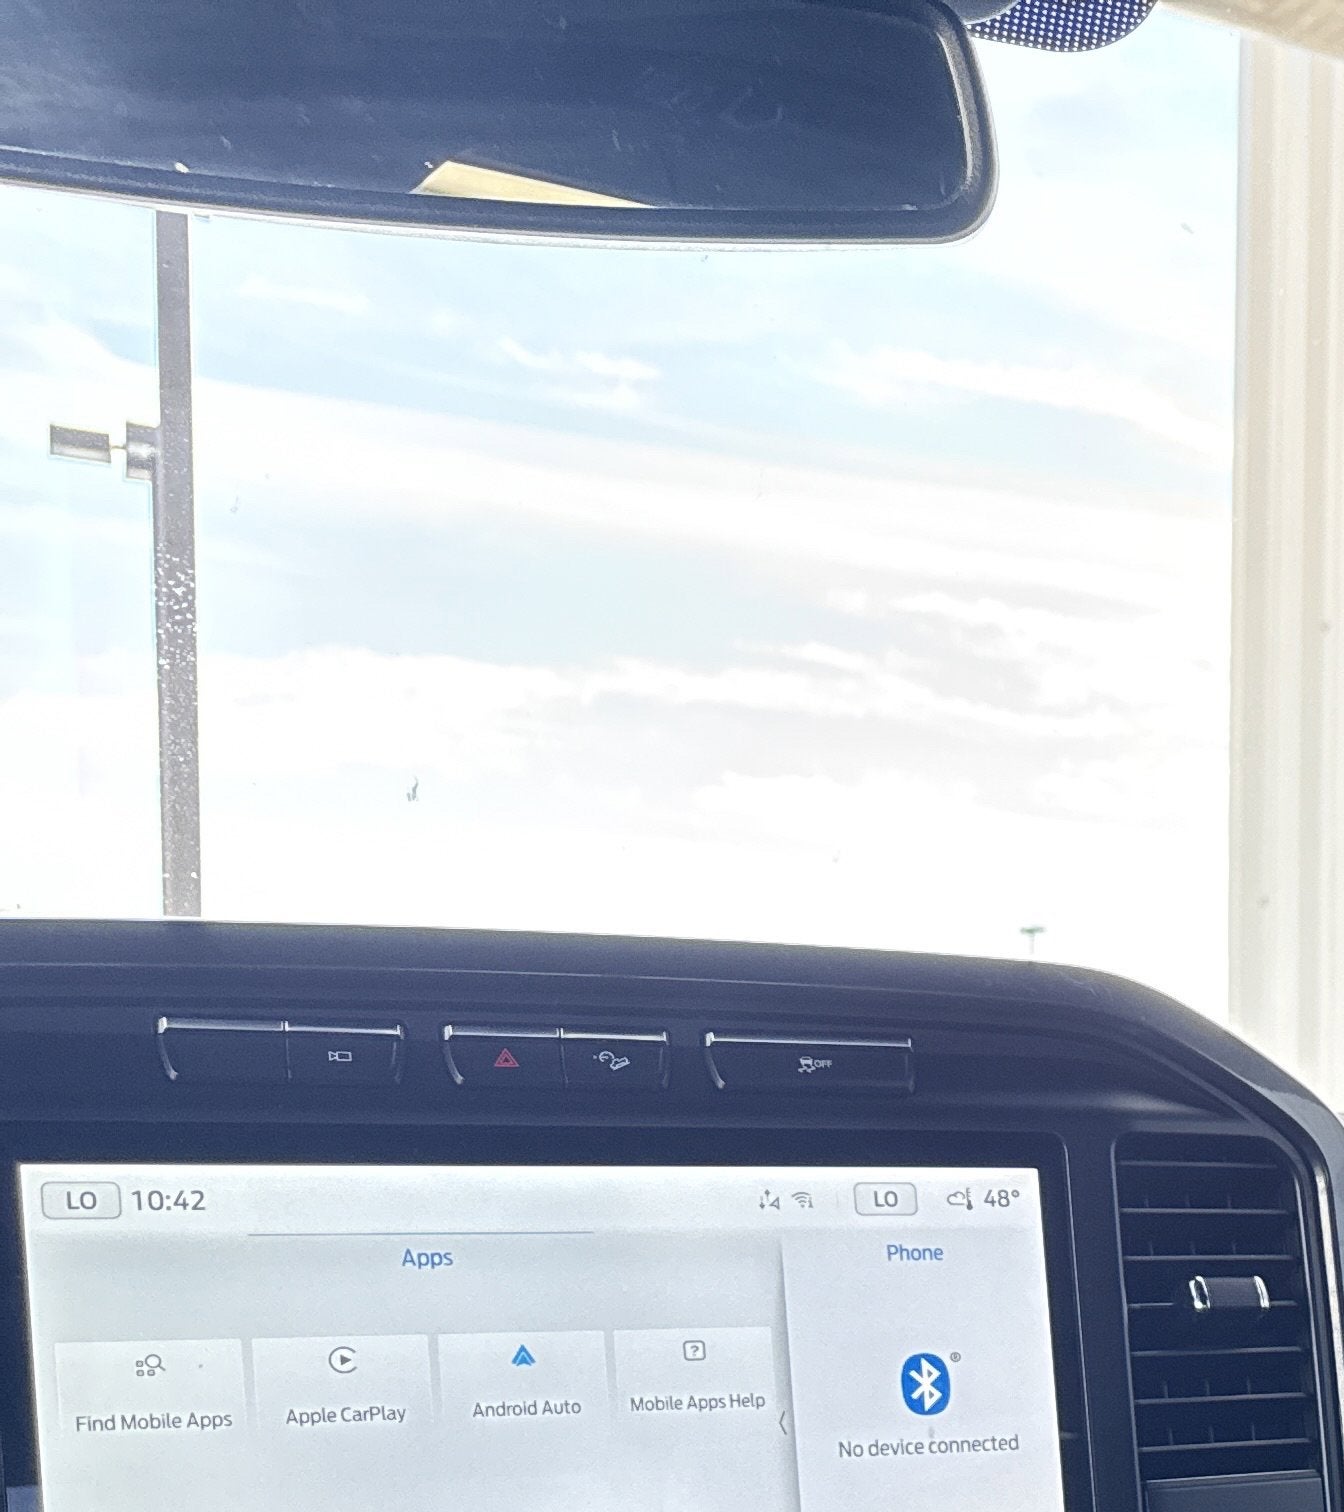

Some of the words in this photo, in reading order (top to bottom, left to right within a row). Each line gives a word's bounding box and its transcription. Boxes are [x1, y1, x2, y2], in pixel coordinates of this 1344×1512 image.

[814, 1059, 832, 1069] OFF
[66, 1190, 97, 1210] LO
[131, 1190, 206, 1211] 10:42
[873, 1190, 898, 1207] LO
[983, 1189, 1020, 1207] 48°
[401, 1248, 454, 1270] Apps
[886, 1244, 944, 1262] Phone
[472, 1400, 538, 1418] Android
[541, 1399, 582, 1415] Auto
[630, 1395, 683, 1412] Mobile
[686, 1395, 727, 1412] Apps
[728, 1392, 766, 1410] Help
[75, 1414, 116, 1432] Find
[120, 1413, 182, 1430] Mobile
[186, 1412, 233, 1430] Apps
[286, 1407, 337, 1427] Apple
[340, 1405, 406, 1424] CarPlay
[838, 1441, 864, 1458] No
[868, 1438, 925, 1457] device
[928, 1434, 1020, 1454] connected
